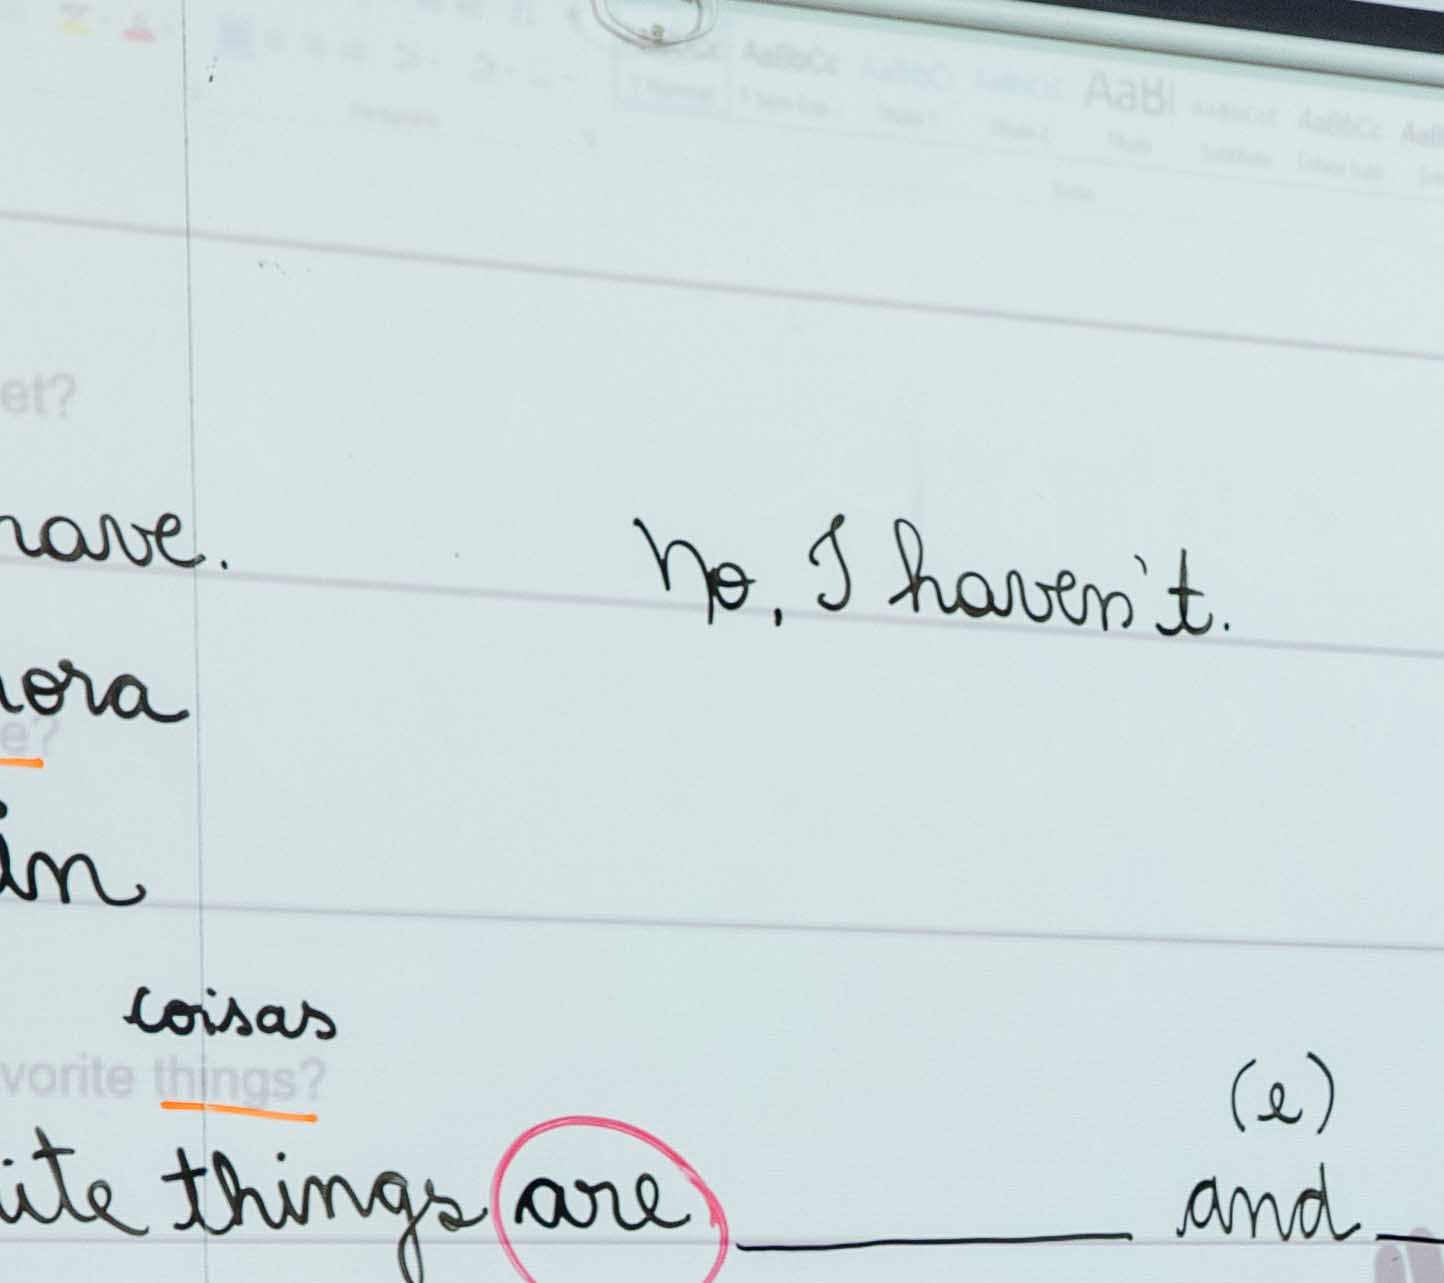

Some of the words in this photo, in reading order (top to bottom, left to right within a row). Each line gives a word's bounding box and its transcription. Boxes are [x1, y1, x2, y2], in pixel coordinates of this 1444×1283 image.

[122, 985, 338, 1041] coisas
[154, 1053, 329, 1106] things?
[515, 1173, 692, 1230] are
[1175, 1162, 1362, 1241] and
